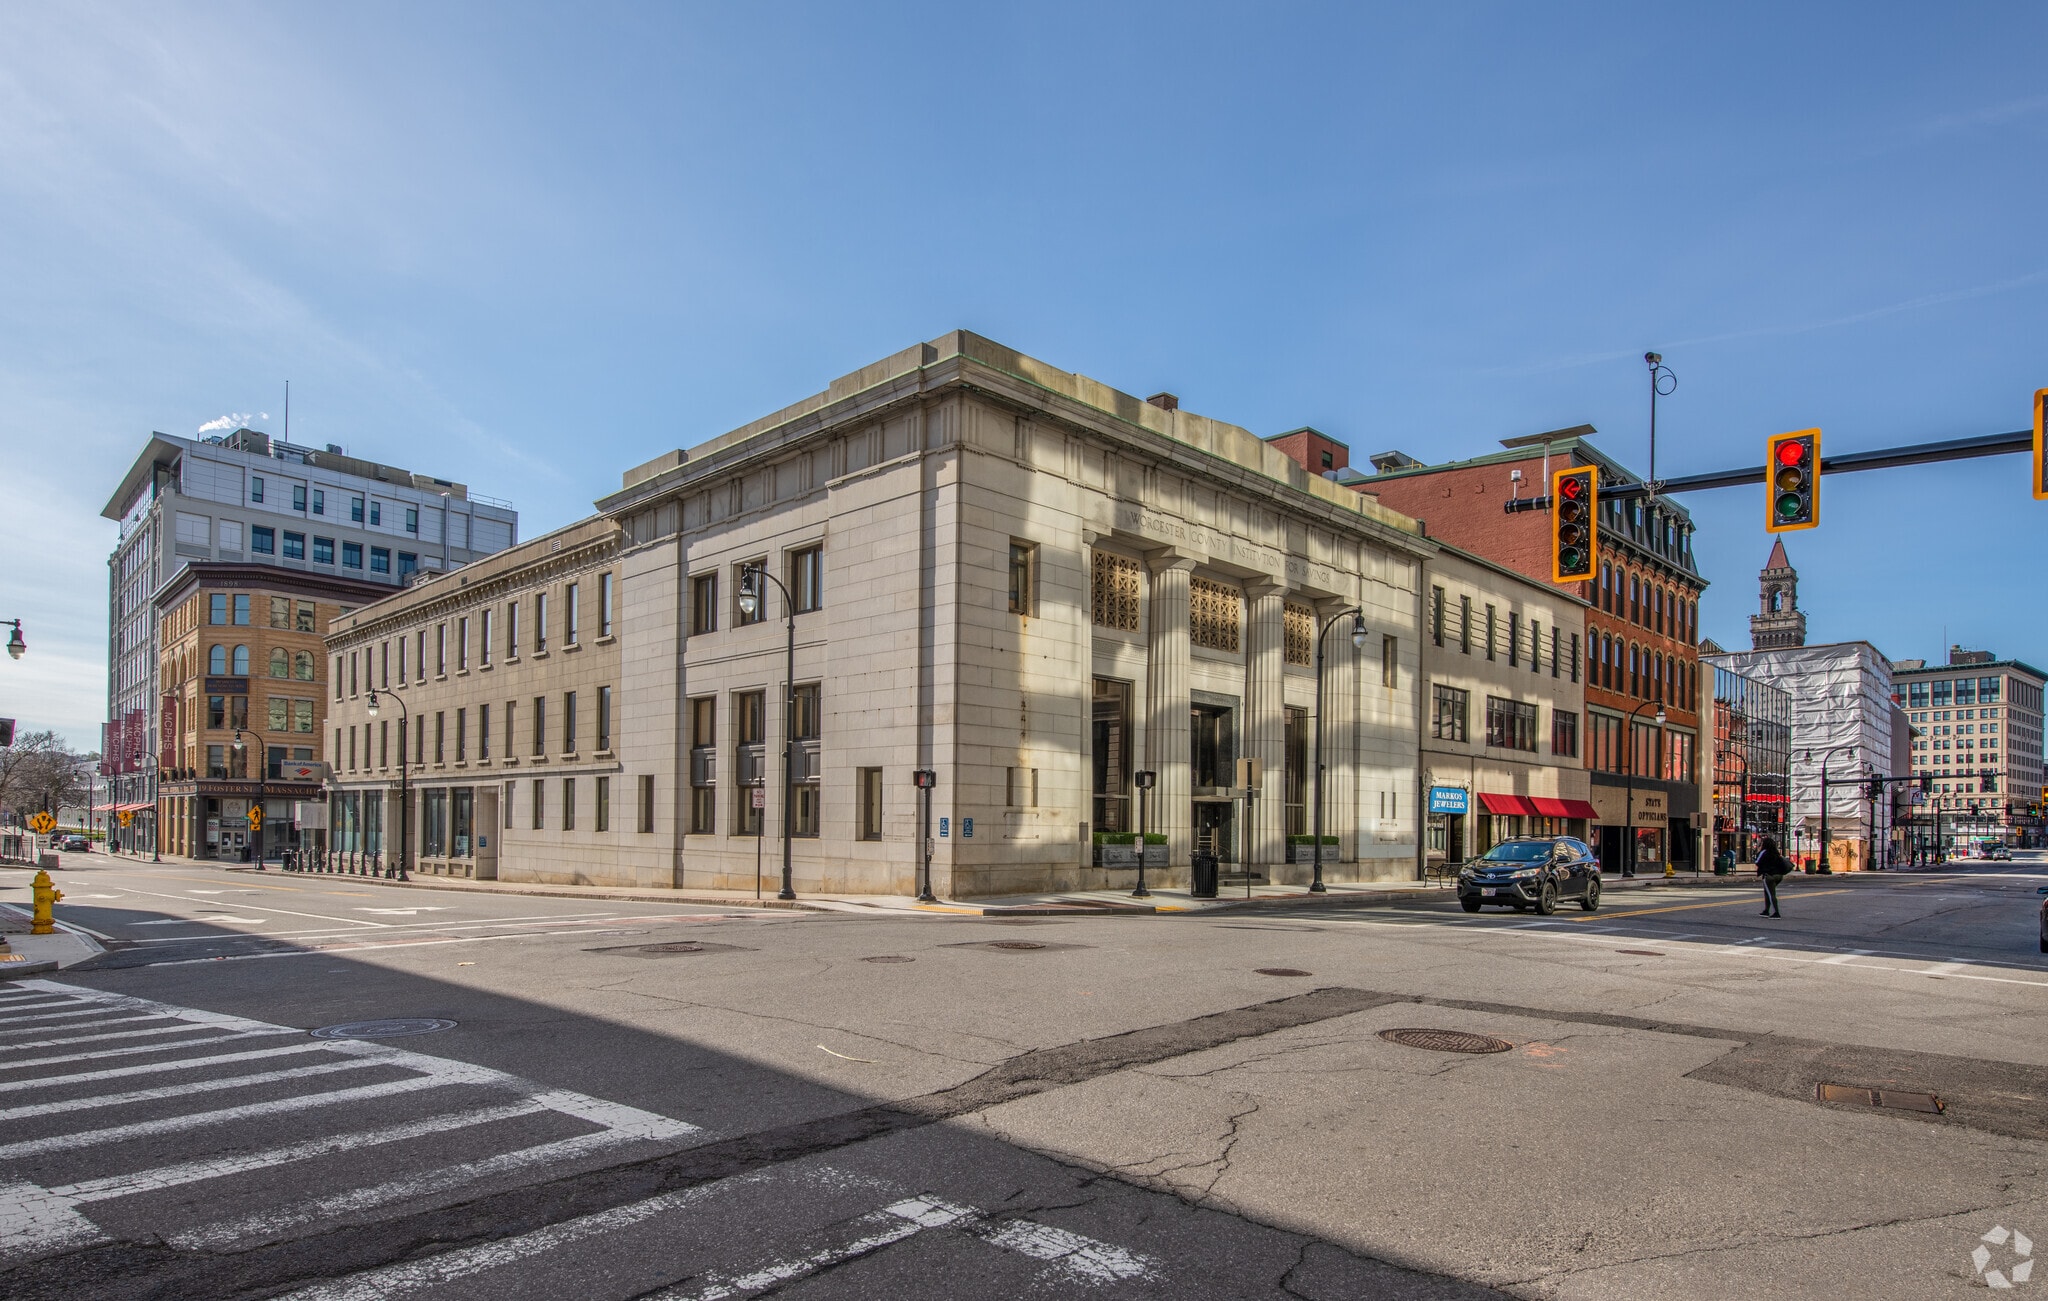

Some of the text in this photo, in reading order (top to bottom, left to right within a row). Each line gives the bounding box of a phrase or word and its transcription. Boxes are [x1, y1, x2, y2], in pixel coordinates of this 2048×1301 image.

[1130, 511, 1186, 540] WORCESTER
[1285, 560, 1299, 575] FOR
[1302, 565, 1330, 584] SAVINGS
[164, 712, 173, 749] MCPHS
[112, 731, 120, 762] MCPHS
[125, 726, 133, 759] MCPHS
[208, 784, 241, 793] FOSTER
[244, 785, 253, 793] ST
[1436, 792, 1462, 800] MARKOS
[1433, 800, 1465, 809] JEWELERS
[1645, 798, 1661, 807] STATE
[1638, 811, 1667, 822] OPTICIANS
